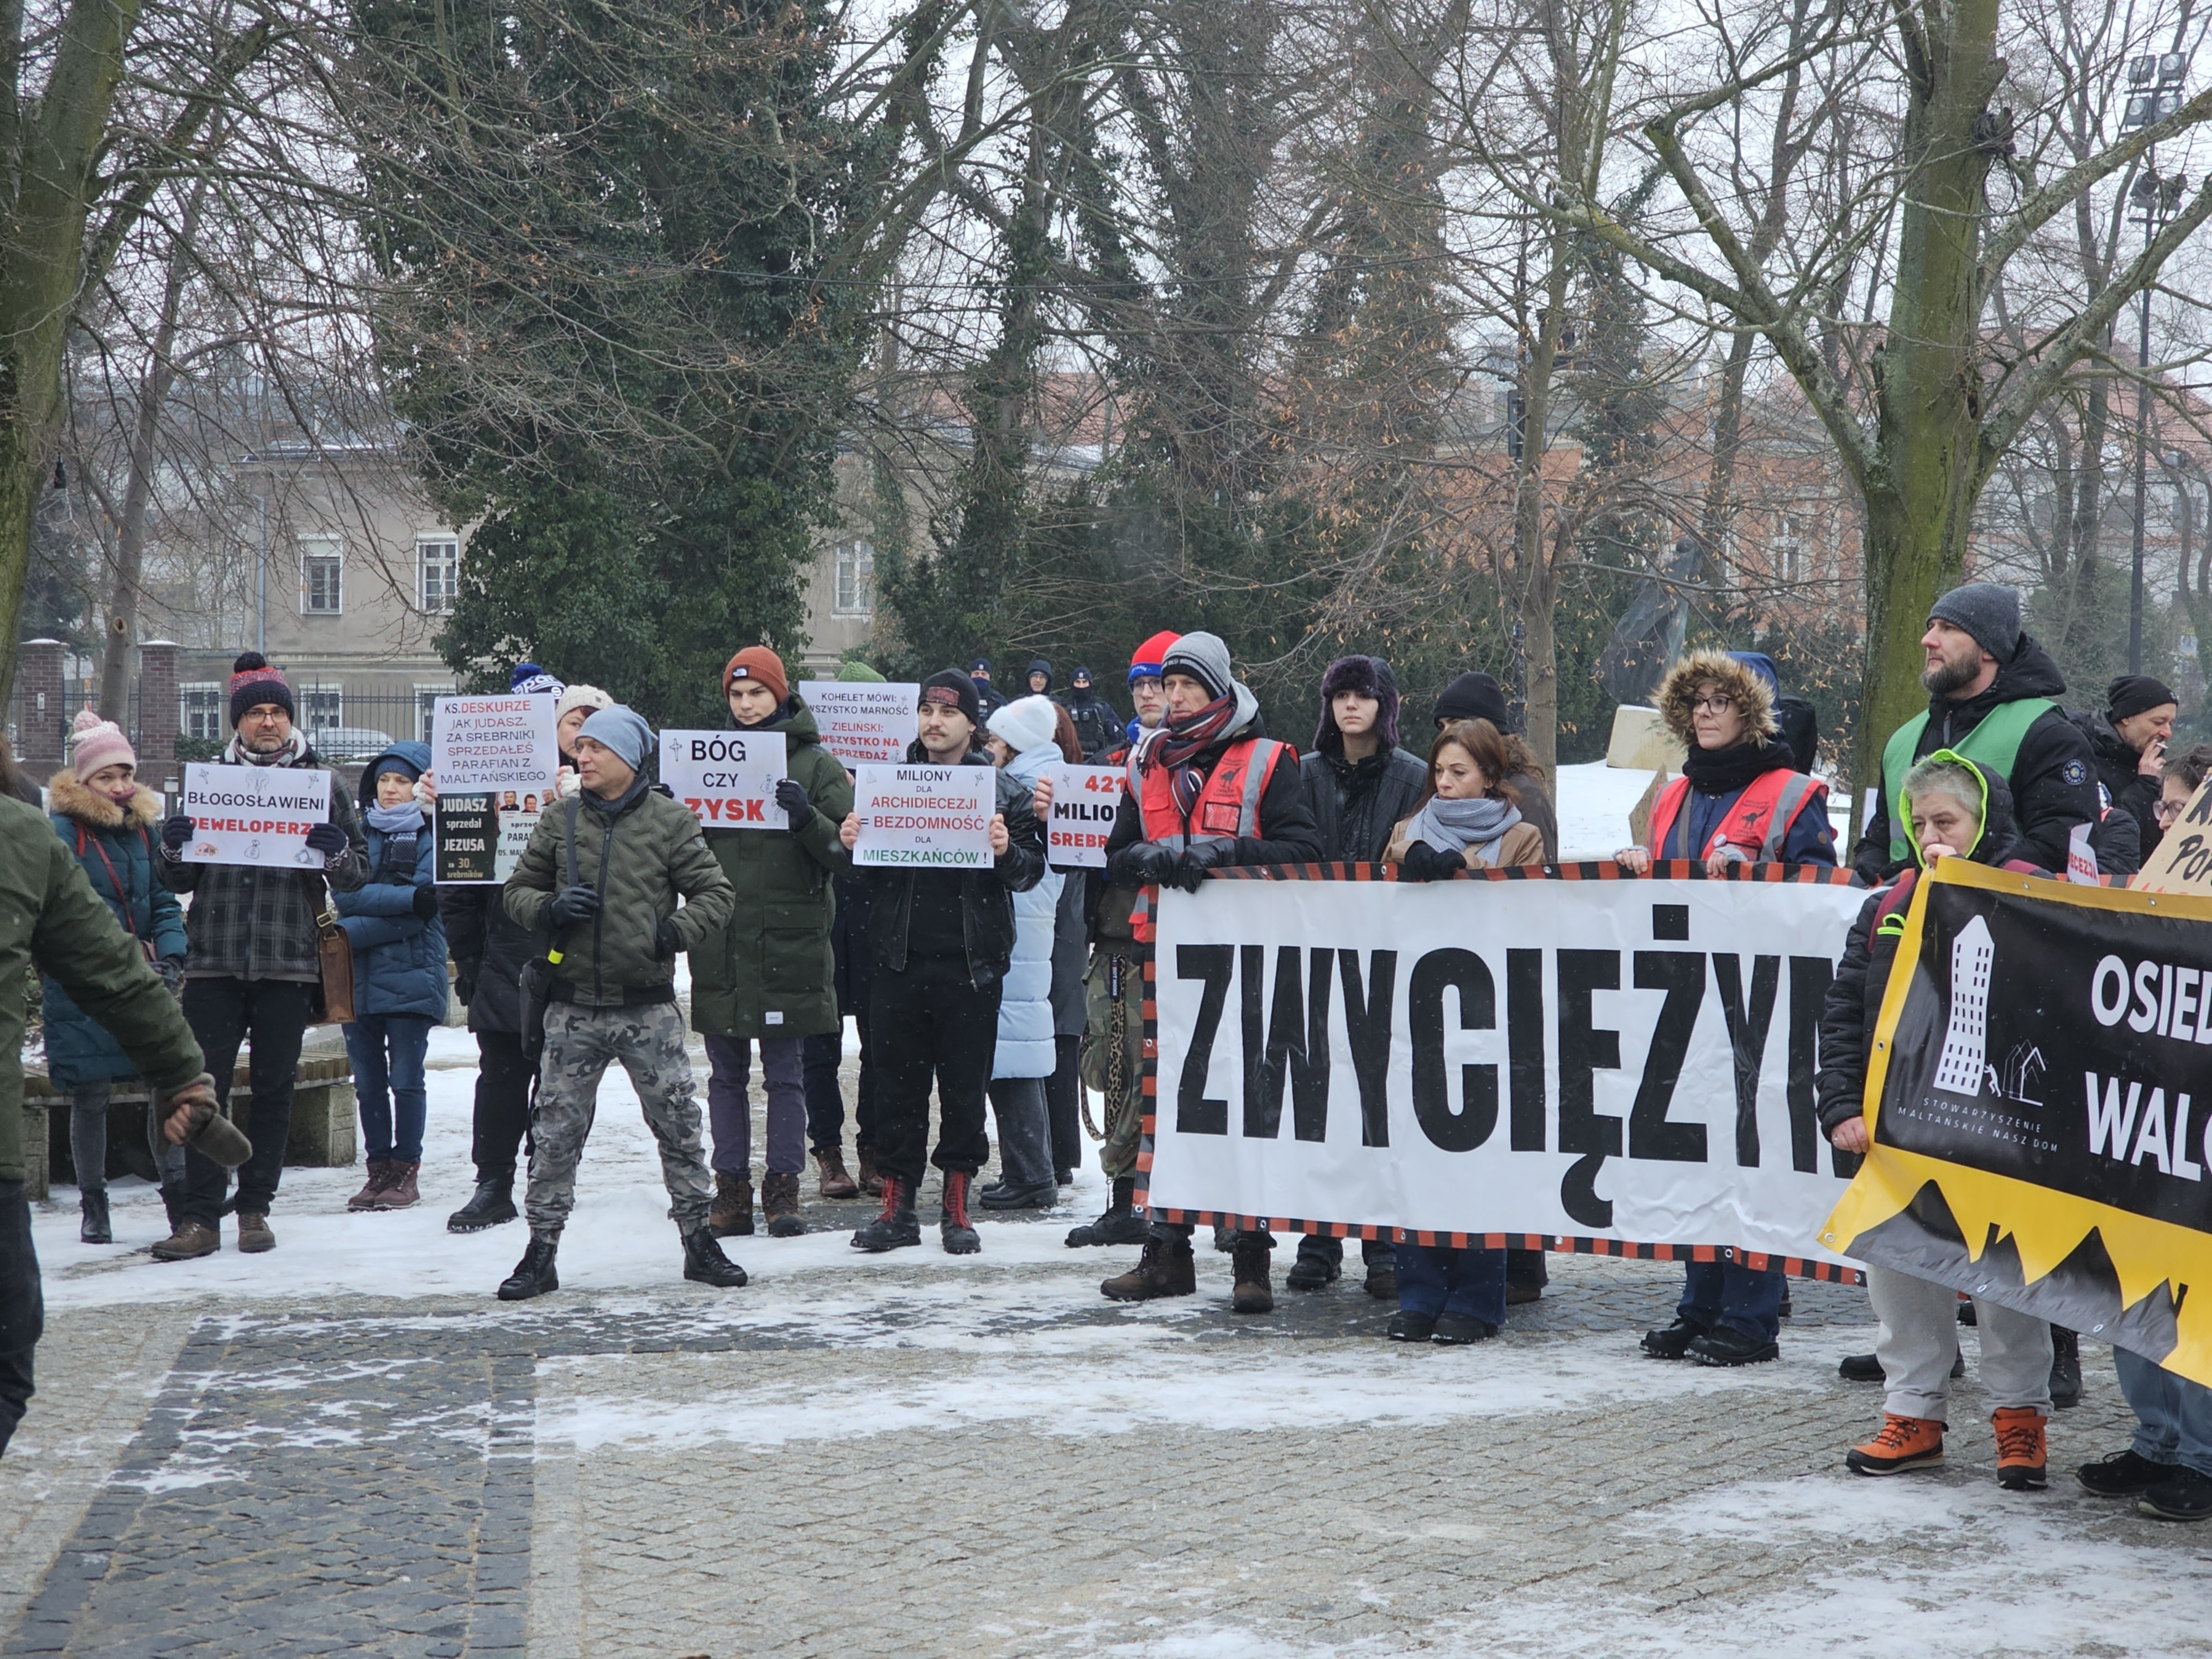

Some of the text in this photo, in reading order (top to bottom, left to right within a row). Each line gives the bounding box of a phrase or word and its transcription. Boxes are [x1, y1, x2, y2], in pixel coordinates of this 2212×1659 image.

[822, 691, 896, 702] KOHELET MÓWI:
[445, 700, 531, 714] KS.DESKURZE
[860, 705, 909, 715] MARNOŚĆ
[451, 717, 526, 731] JAK JUDASZ.
[832, 721, 883, 732] ZIELIŃSKI:
[446, 730, 535, 742] ZA SREBRNIKI
[820, 735, 899, 747] WSZYSTKO NA
[448, 742, 534, 757] SPRZEDAŁEŚ
[691, 734, 746, 761] BÓG
[832, 748, 888, 760] SPRZEDAŻ
[452, 758, 531, 770] PARAFIAN Z
[441, 771, 546, 784] MALTAŃSKIEGO
[703, 773, 738, 787] CZY
[897, 770, 952, 781] MILIONY
[1085, 775, 1125, 793] 421
[188, 791, 324, 810] BŁOGOSŁAWIENI
[442, 799, 487, 812] JUDASZ
[871, 797, 977, 809] ARCHIDIECEZJI
[684, 798, 765, 821] ZYSK
[1054, 802, 1120, 821] MILIO
[189, 816, 312, 836] DEWELOPERZ
[446, 818, 482, 831] sprzedał
[874, 815, 984, 831] BEZDOMNOŚĆ
[508, 833, 531, 841] PARA
[444, 838, 485, 852] JEZUSA
[458, 858, 470, 868] 30
[863, 848, 978, 864] MIESZKAŃCÓW
[447, 870, 483, 878] srebrników
[1923, 1097, 2042, 1133] STOWARZYSZENIE
[1898, 1107, 2058, 1152] MALTAŃSKIE NASZ DOM
[2085, 1071, 2212, 1182] WAL
